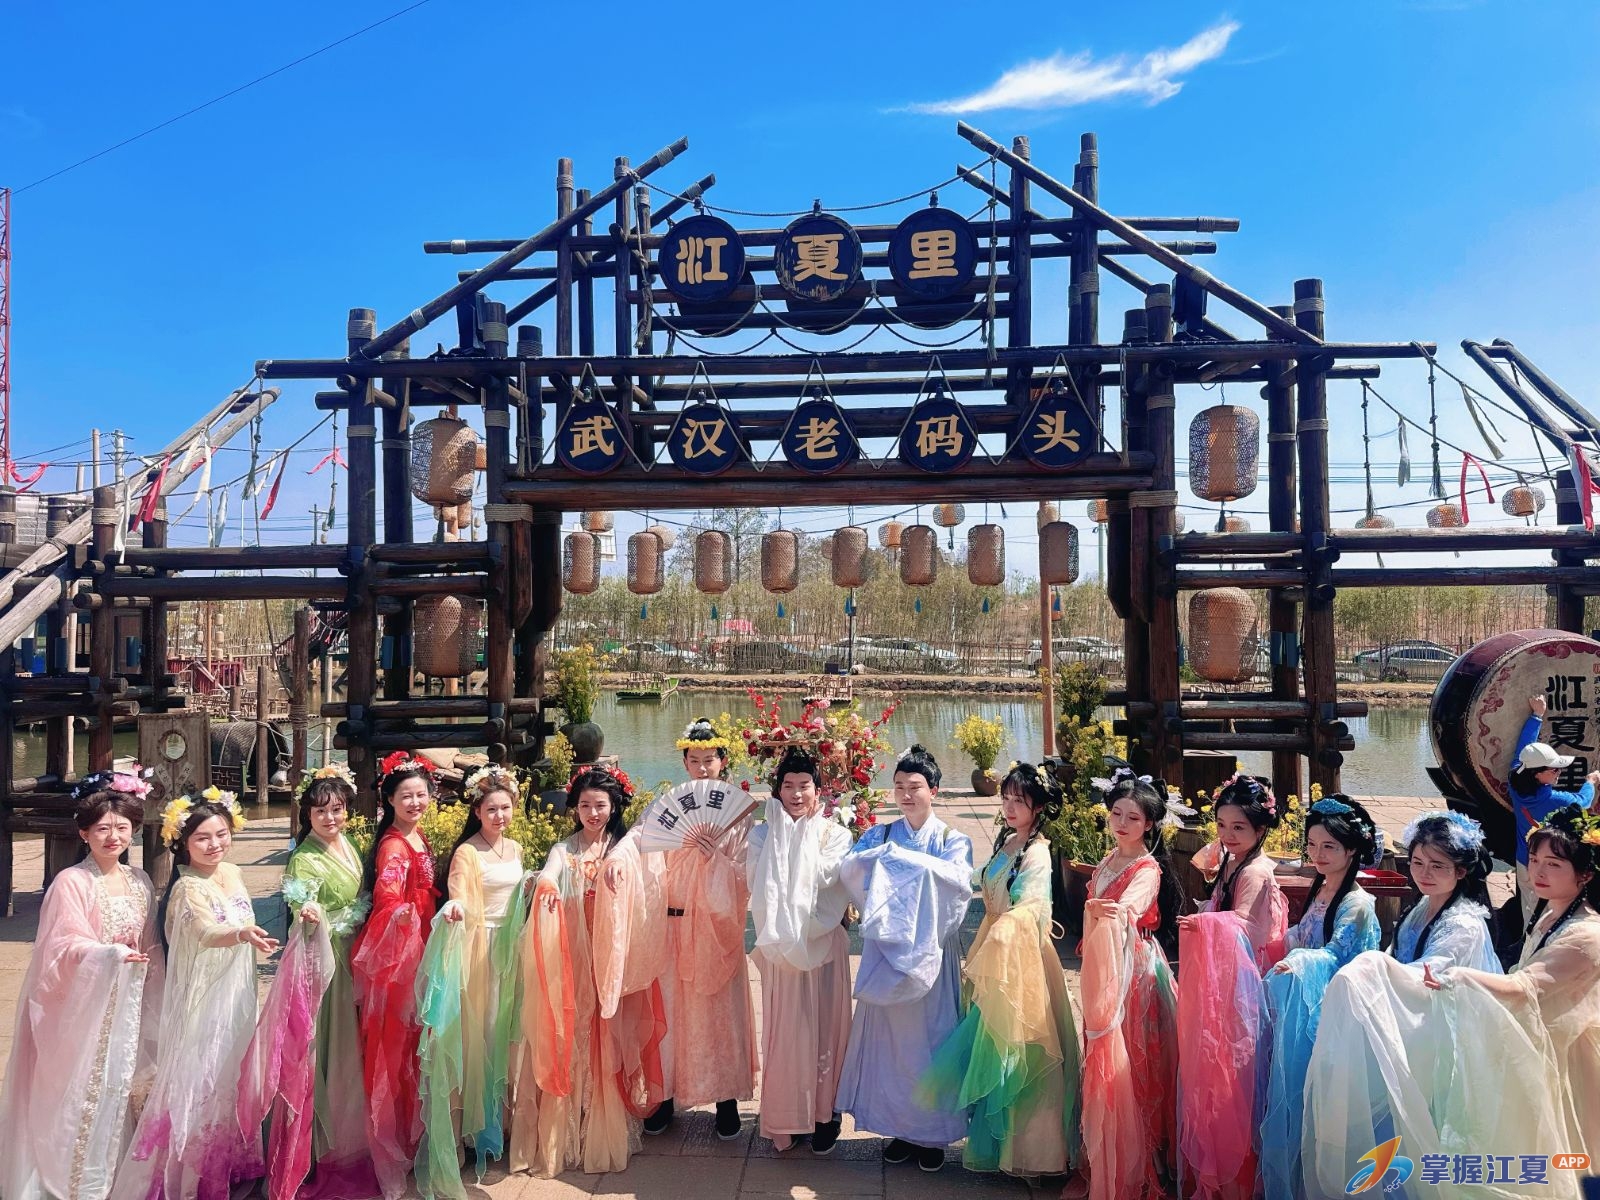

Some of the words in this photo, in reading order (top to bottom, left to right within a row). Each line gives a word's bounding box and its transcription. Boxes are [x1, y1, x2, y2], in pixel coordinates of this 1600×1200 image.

[675, 229, 959, 285] 江夏里
[568, 410, 1080, 461] 武汉老码头
[656, 789, 725, 831] 江夏里
